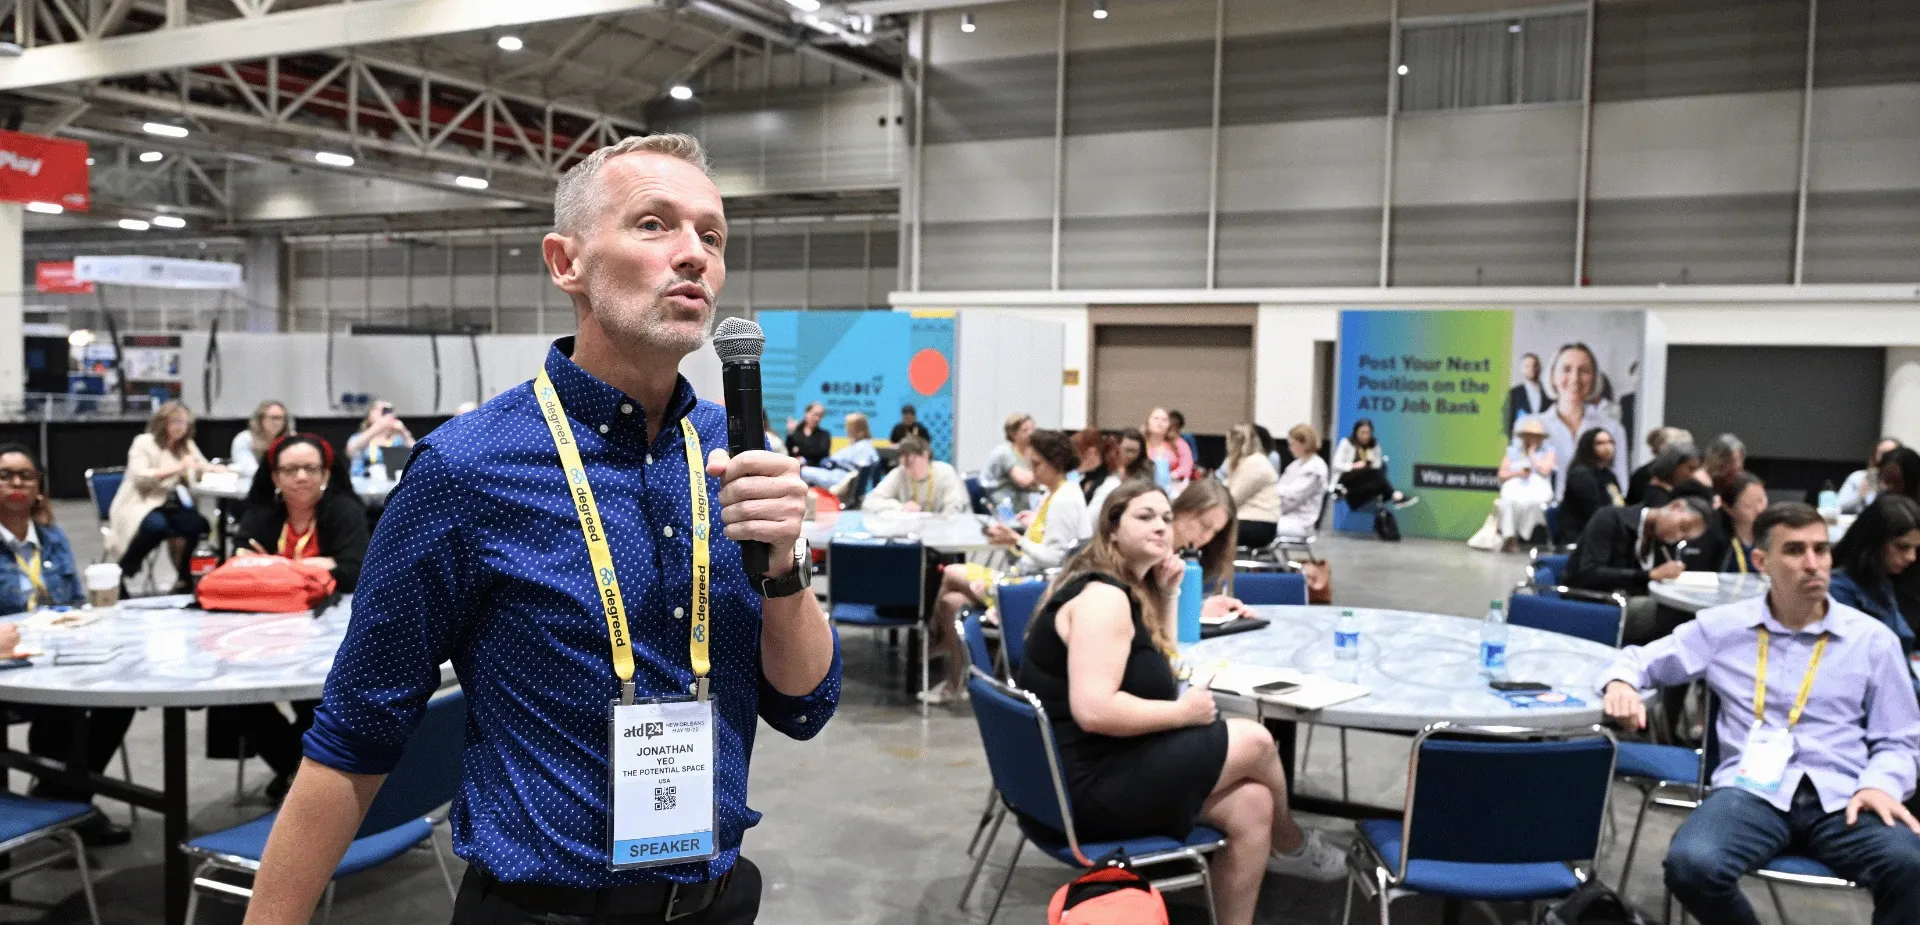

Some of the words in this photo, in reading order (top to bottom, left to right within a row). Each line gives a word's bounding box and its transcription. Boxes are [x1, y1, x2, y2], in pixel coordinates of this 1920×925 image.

[1359, 355, 1396, 371] Post
[1402, 356, 1441, 372] Your
[1446, 356, 1490, 372] Next
[1358, 375, 1429, 392] Position
[1432, 381, 1456, 393] on
[1460, 378, 1489, 393] the
[1358, 397, 1396, 412] ATD
[1401, 399, 1431, 414] Job
[1435, 399, 1479, 414] Bank
[545, 401, 570, 445] degreed
[1421, 470, 1444, 484] We
[1446, 474, 1468, 485] are
[694, 470, 706, 521] degreed
[576, 487, 600, 542] degreed
[695, 565, 706, 621] degreed
[605, 588, 626, 647] degreed
[624, 723, 644, 738] atd
[647, 723, 663, 736] 24
[636, 744, 694, 757] JONATHAN
[656, 757, 675, 765] YEO
[639, 767, 680, 776] POTENTIAL
[681, 764, 705, 773] SPACE
[629, 838, 700, 858] SPEAKER
